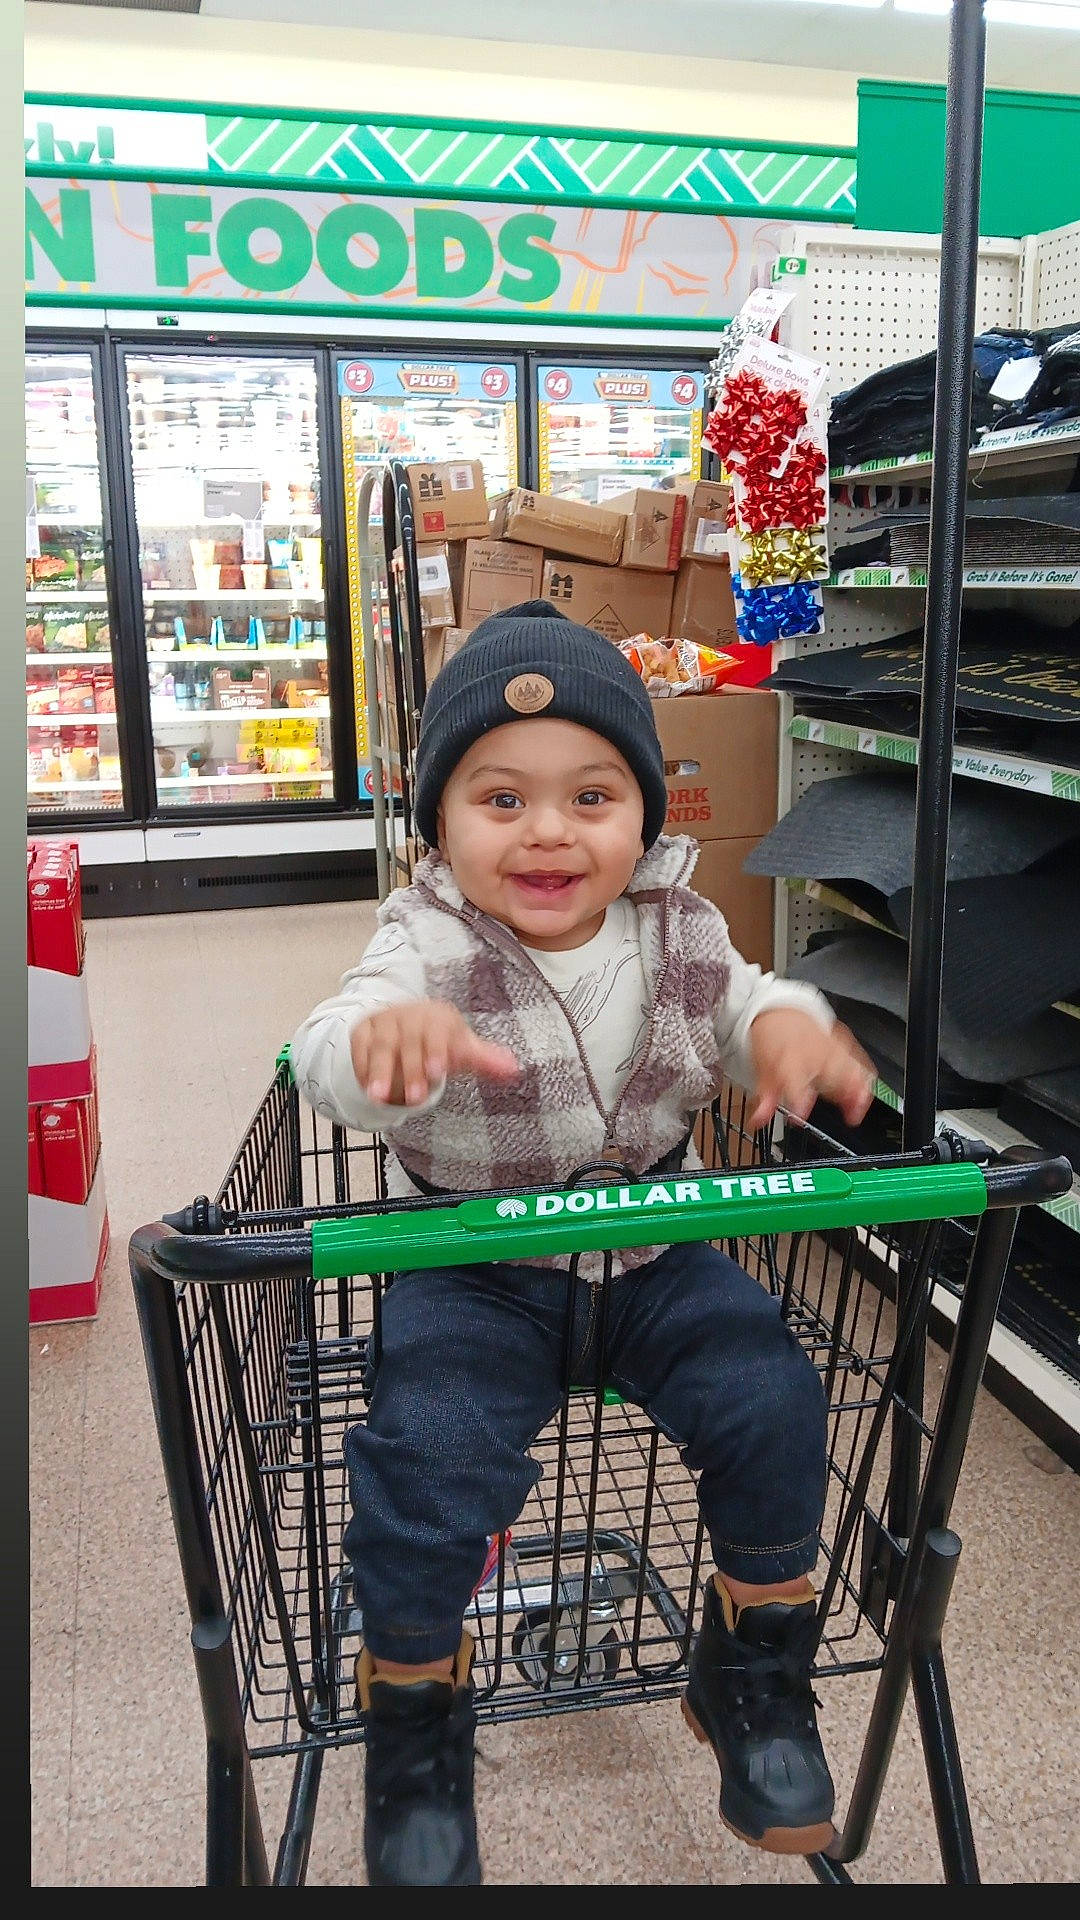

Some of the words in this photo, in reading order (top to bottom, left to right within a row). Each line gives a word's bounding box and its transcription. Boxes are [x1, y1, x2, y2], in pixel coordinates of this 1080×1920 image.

[151, 193, 562, 302] FOODS
[347, 369, 368, 386] $3
[750, 355, 783, 375] Deluxe
[785, 370, 809, 386] Bows
[813, 367, 821, 376] 4
[410, 374, 454, 388] PLUS!
[484, 374, 503, 391] $3
[547, 377, 568, 394] $4
[604, 382, 647, 396] PLUS!
[673, 383, 693, 399] $4
[813, 409, 820, 417] 4
[967, 570, 988, 582] Grab
[998, 570, 1028, 582] Before
[1029, 570, 1044, 582] It's
[1045, 570, 1079, 582] Gone!
[964, 758, 989, 773] Value
[989, 763, 1034, 786] Everyday
[535, 1182, 702, 1217] DOLLAR
[713, 1172, 816, 1199] TREE
